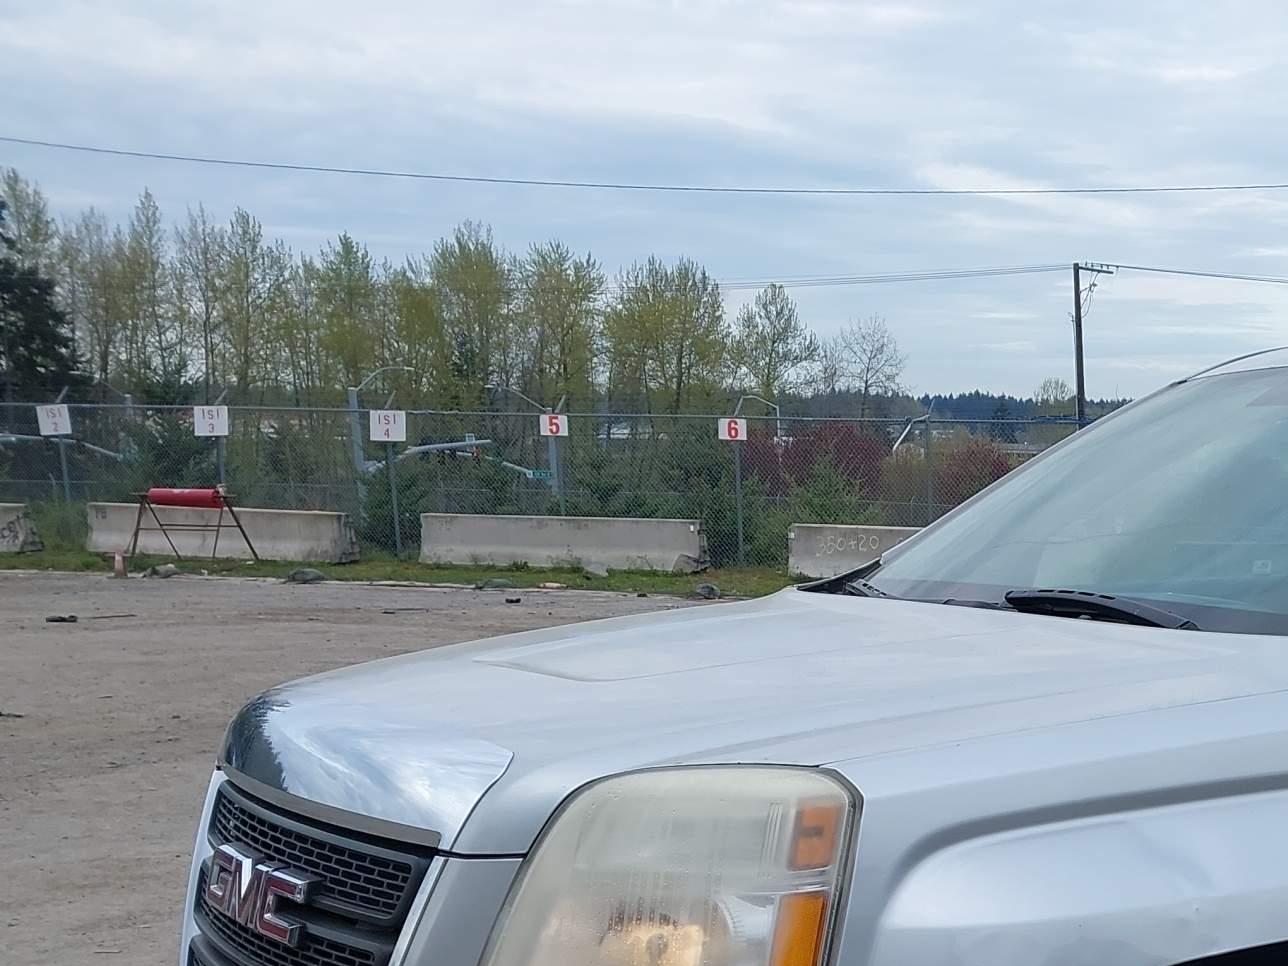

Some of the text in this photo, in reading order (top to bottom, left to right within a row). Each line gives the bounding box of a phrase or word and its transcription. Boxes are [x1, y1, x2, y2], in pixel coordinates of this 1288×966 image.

[207, 422, 215, 433] 3
[383, 428, 391, 439] 4
[548, 415, 560, 436] 5
[727, 419, 739, 439] 6
[206, 843, 306, 948] GMC
